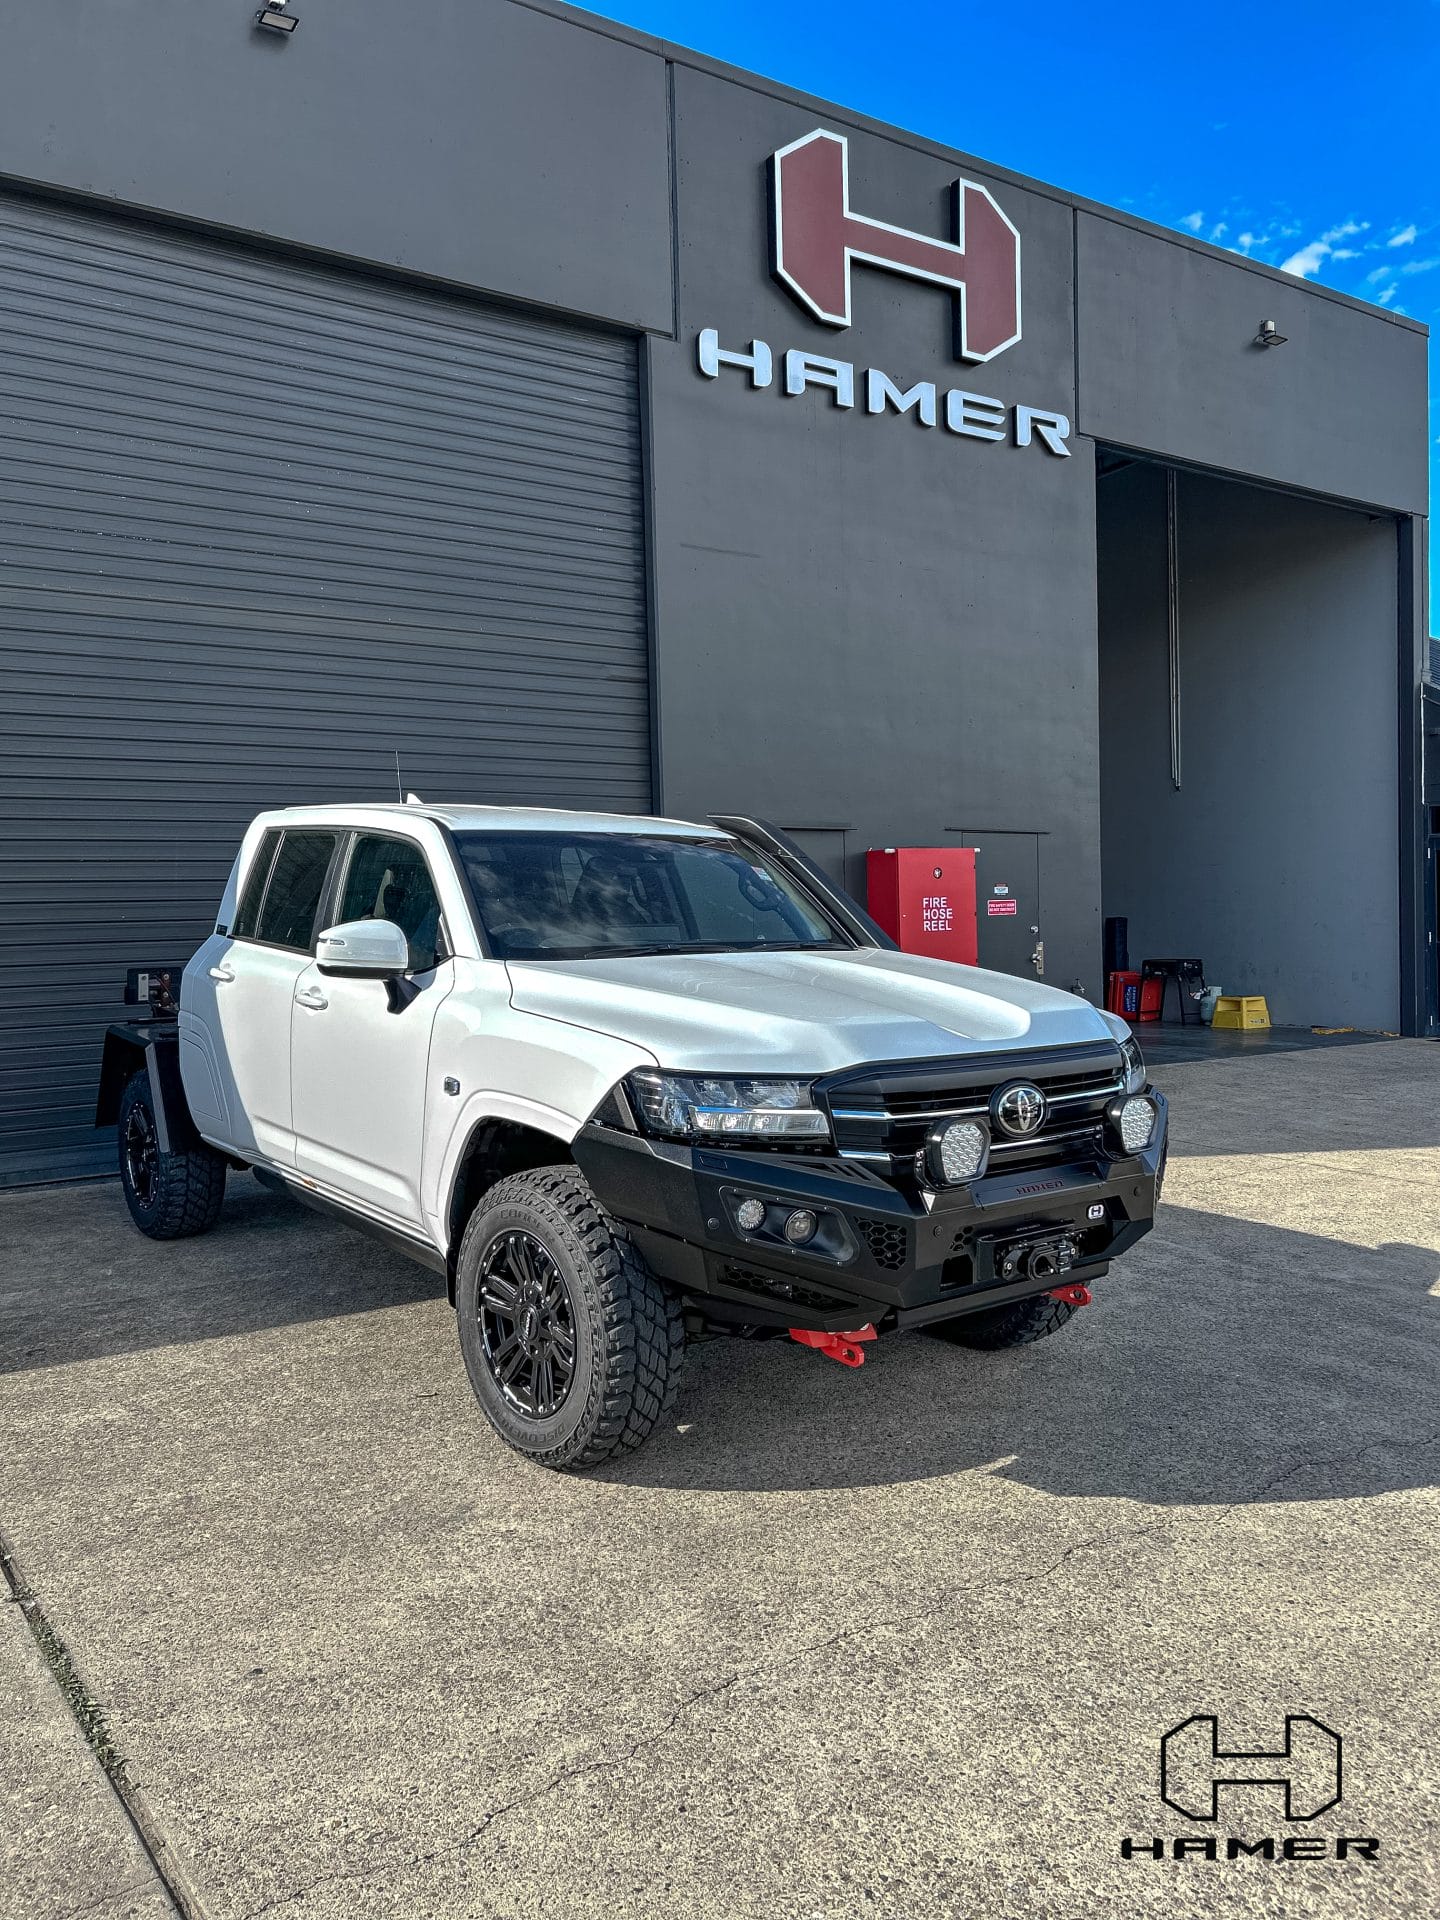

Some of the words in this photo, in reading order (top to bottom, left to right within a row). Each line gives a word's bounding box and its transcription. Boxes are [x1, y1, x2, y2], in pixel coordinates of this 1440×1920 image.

[697, 328, 1072, 457] HAMER
[922, 897, 948, 908] FIRE
[923, 908, 953, 919] HOSE
[923, 920, 952, 931] REEL
[1015, 1180, 1065, 1195] HAMER
